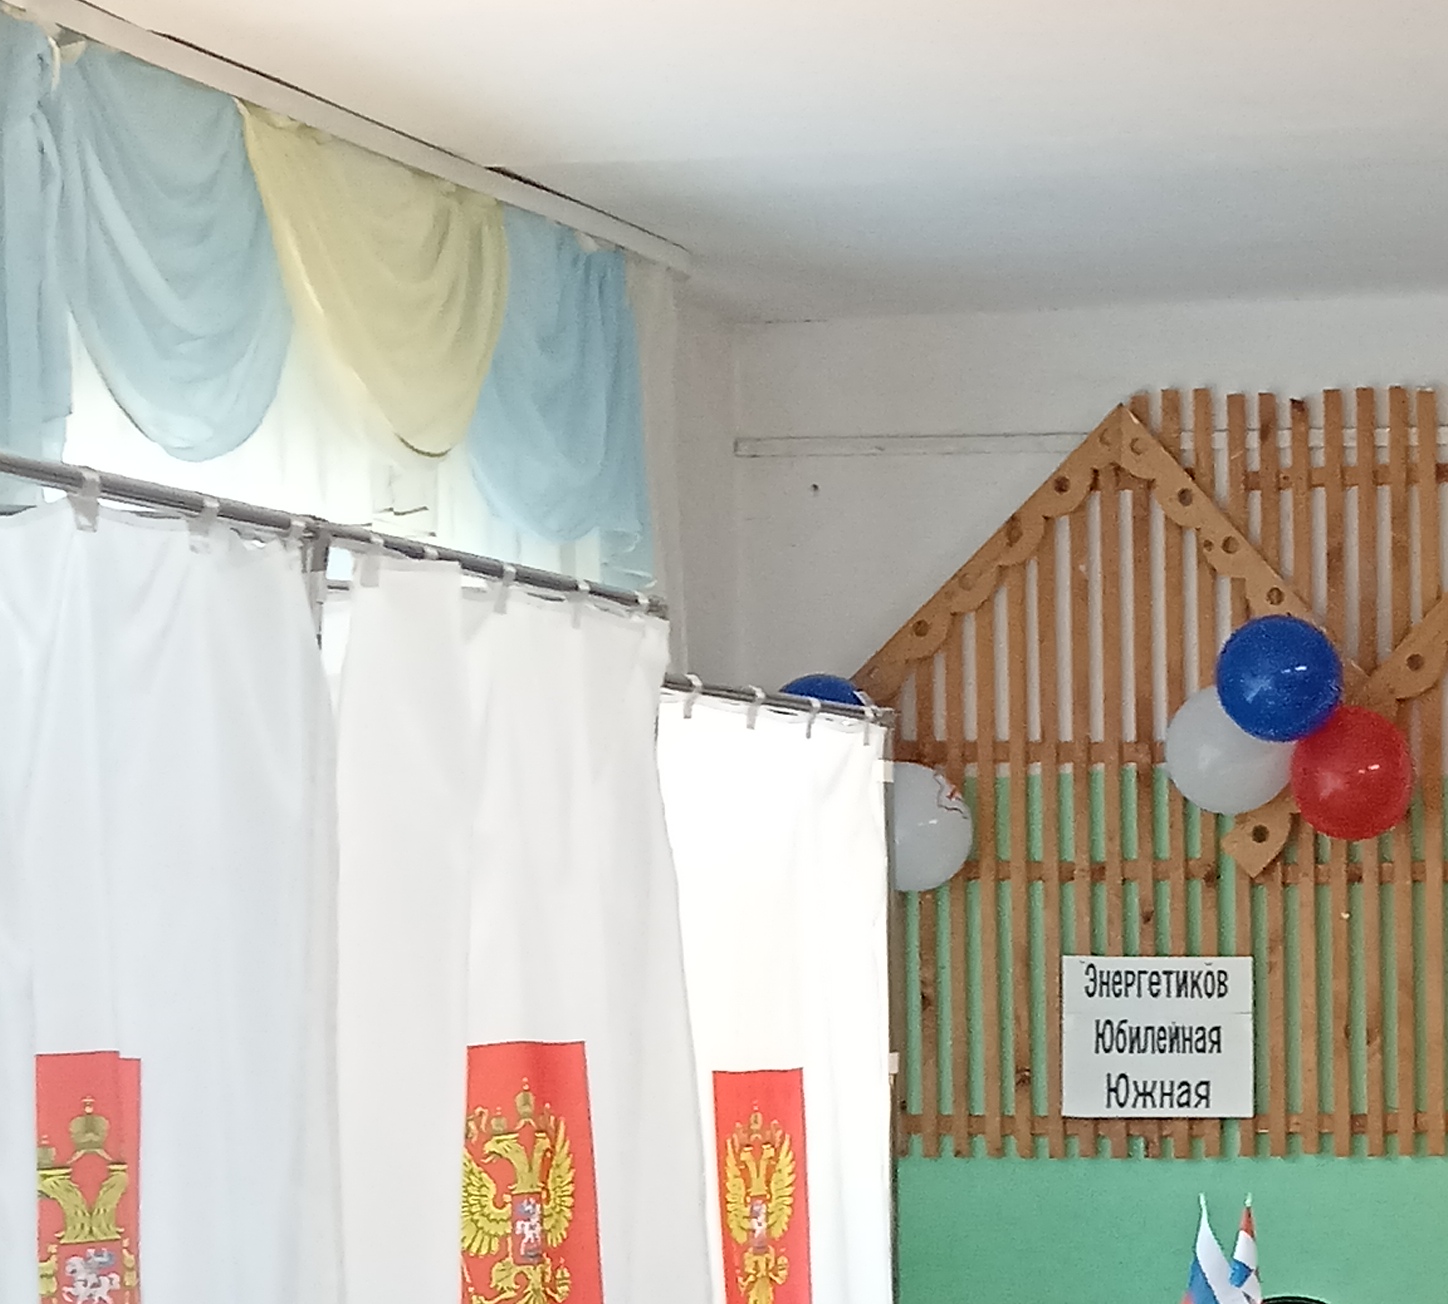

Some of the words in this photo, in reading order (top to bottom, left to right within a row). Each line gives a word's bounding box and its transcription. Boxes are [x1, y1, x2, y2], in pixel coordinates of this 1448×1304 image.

[1084, 963, 1229, 998] Энергетиков
[1094, 1019, 1223, 1054] Юбилейная
[1105, 1072, 1212, 1109] Южная
